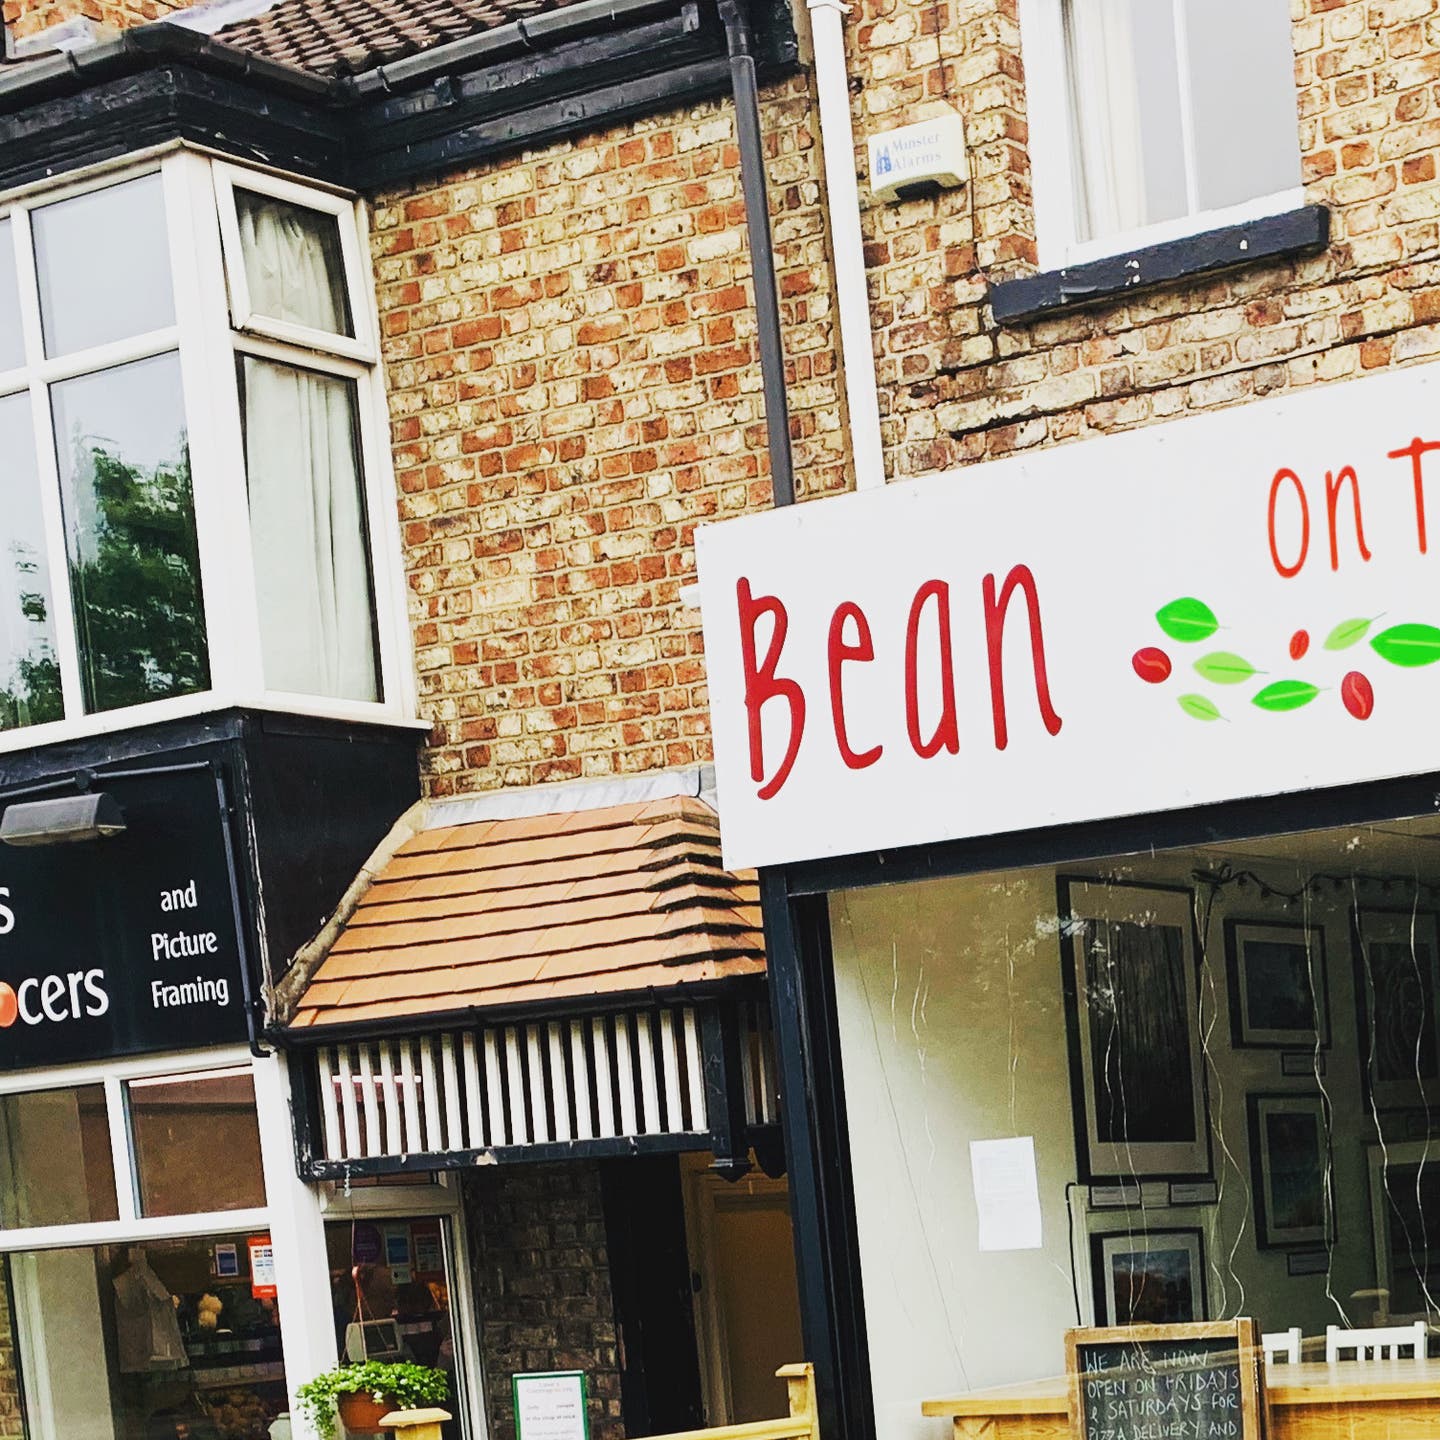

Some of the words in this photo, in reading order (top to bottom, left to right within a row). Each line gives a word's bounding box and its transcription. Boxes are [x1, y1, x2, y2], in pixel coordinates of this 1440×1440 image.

[892, 133, 940, 152] Minster
[892, 153, 942, 171] Alarms
[736, 563, 1063, 801] Bean
[160, 879, 198, 912] and
[150, 930, 218, 961] Picture
[150, 976, 230, 1008] Framing
[1085, 1351, 1108, 1375] WE
[1120, 1350, 1156, 1375] ARE
[1163, 1350, 1209, 1369] NOW
[1088, 1379, 1126, 1399] OPEN
[1135, 1377, 1156, 1395] ON
[1166, 1369, 1239, 1392] FRIDAYS
[1108, 1393, 1202, 1420] SATURDAYS
[1212, 1392, 1239, 1409] FOR
[1209, 1420, 1238, 1437] AND
